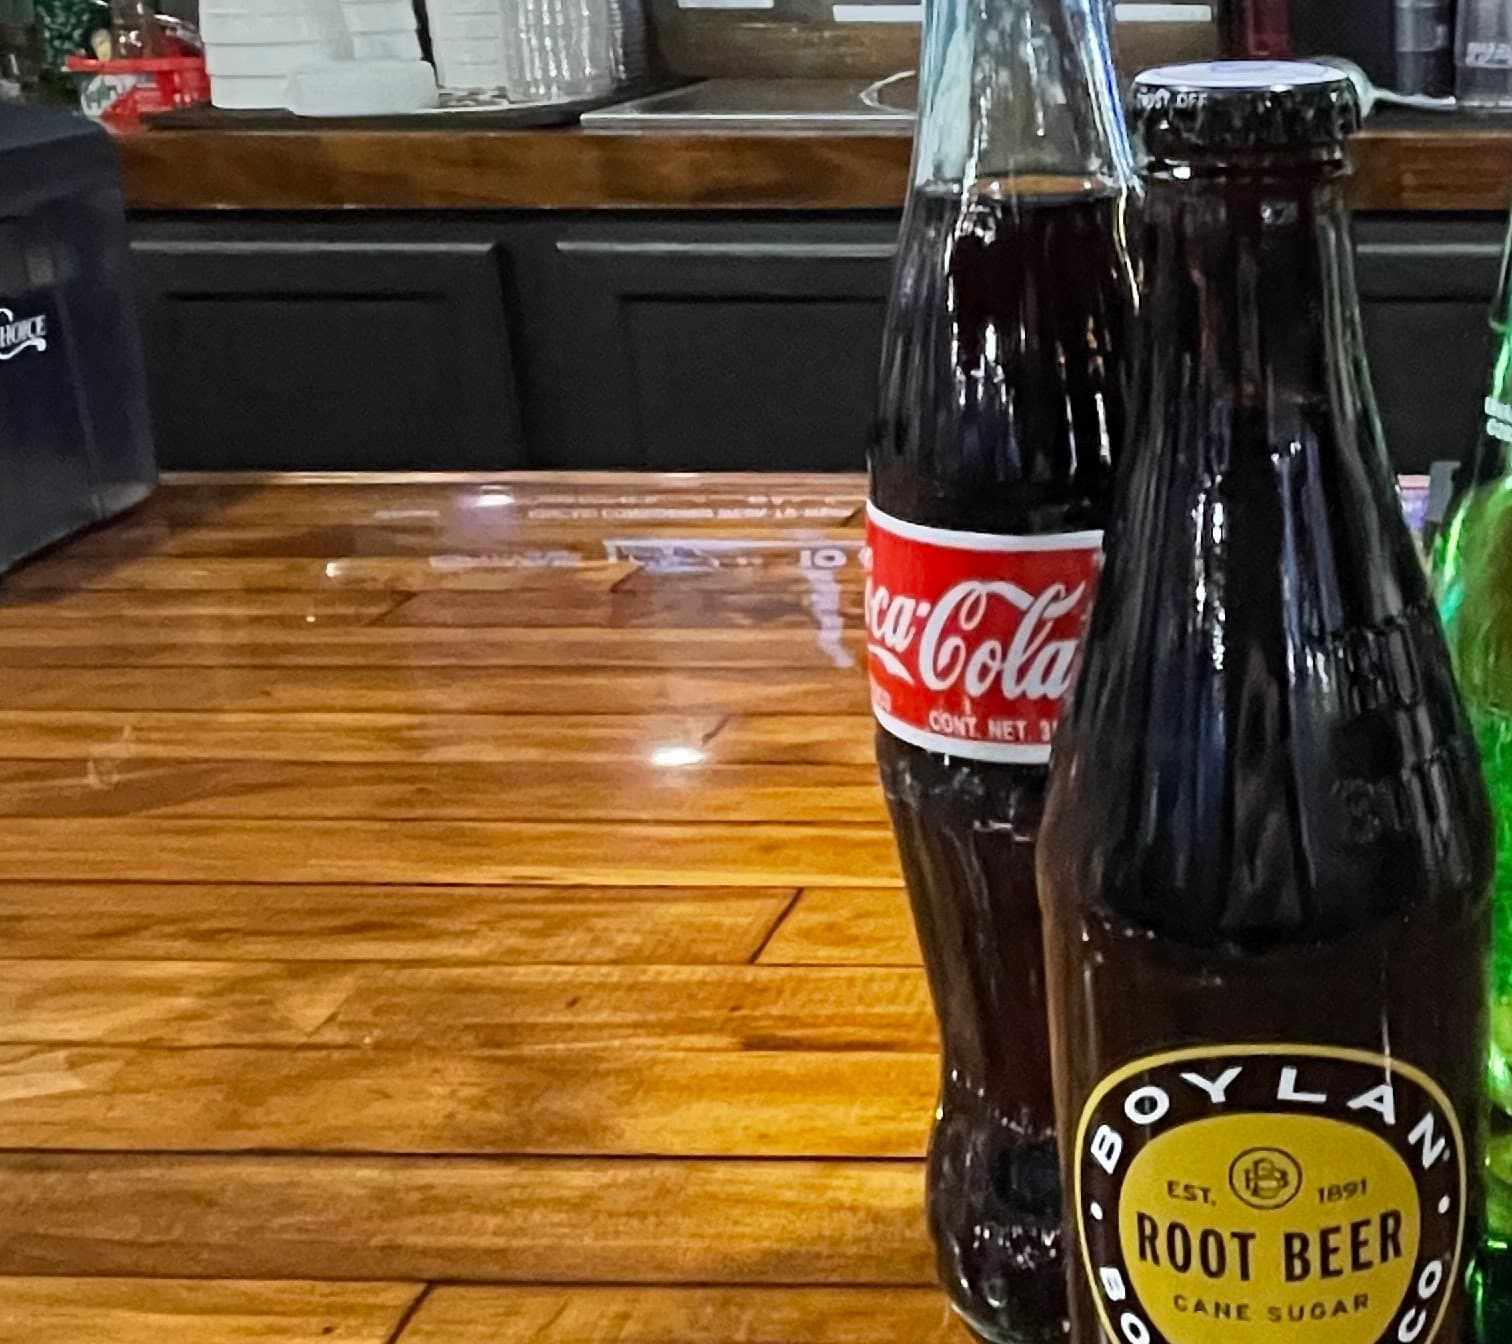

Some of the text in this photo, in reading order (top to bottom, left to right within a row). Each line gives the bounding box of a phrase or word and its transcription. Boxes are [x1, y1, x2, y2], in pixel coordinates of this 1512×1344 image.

[865, 579, 1086, 700] ca-Cola
[928, 709, 980, 739] CONT.
[1090, 1065, 1446, 1175] BOYLAN
[1166, 1178, 1368, 1207] EST. 1891
[1136, 1208, 1403, 1283] ROOT BEER
[1174, 1292, 1370, 1323] CANE SUGAR
